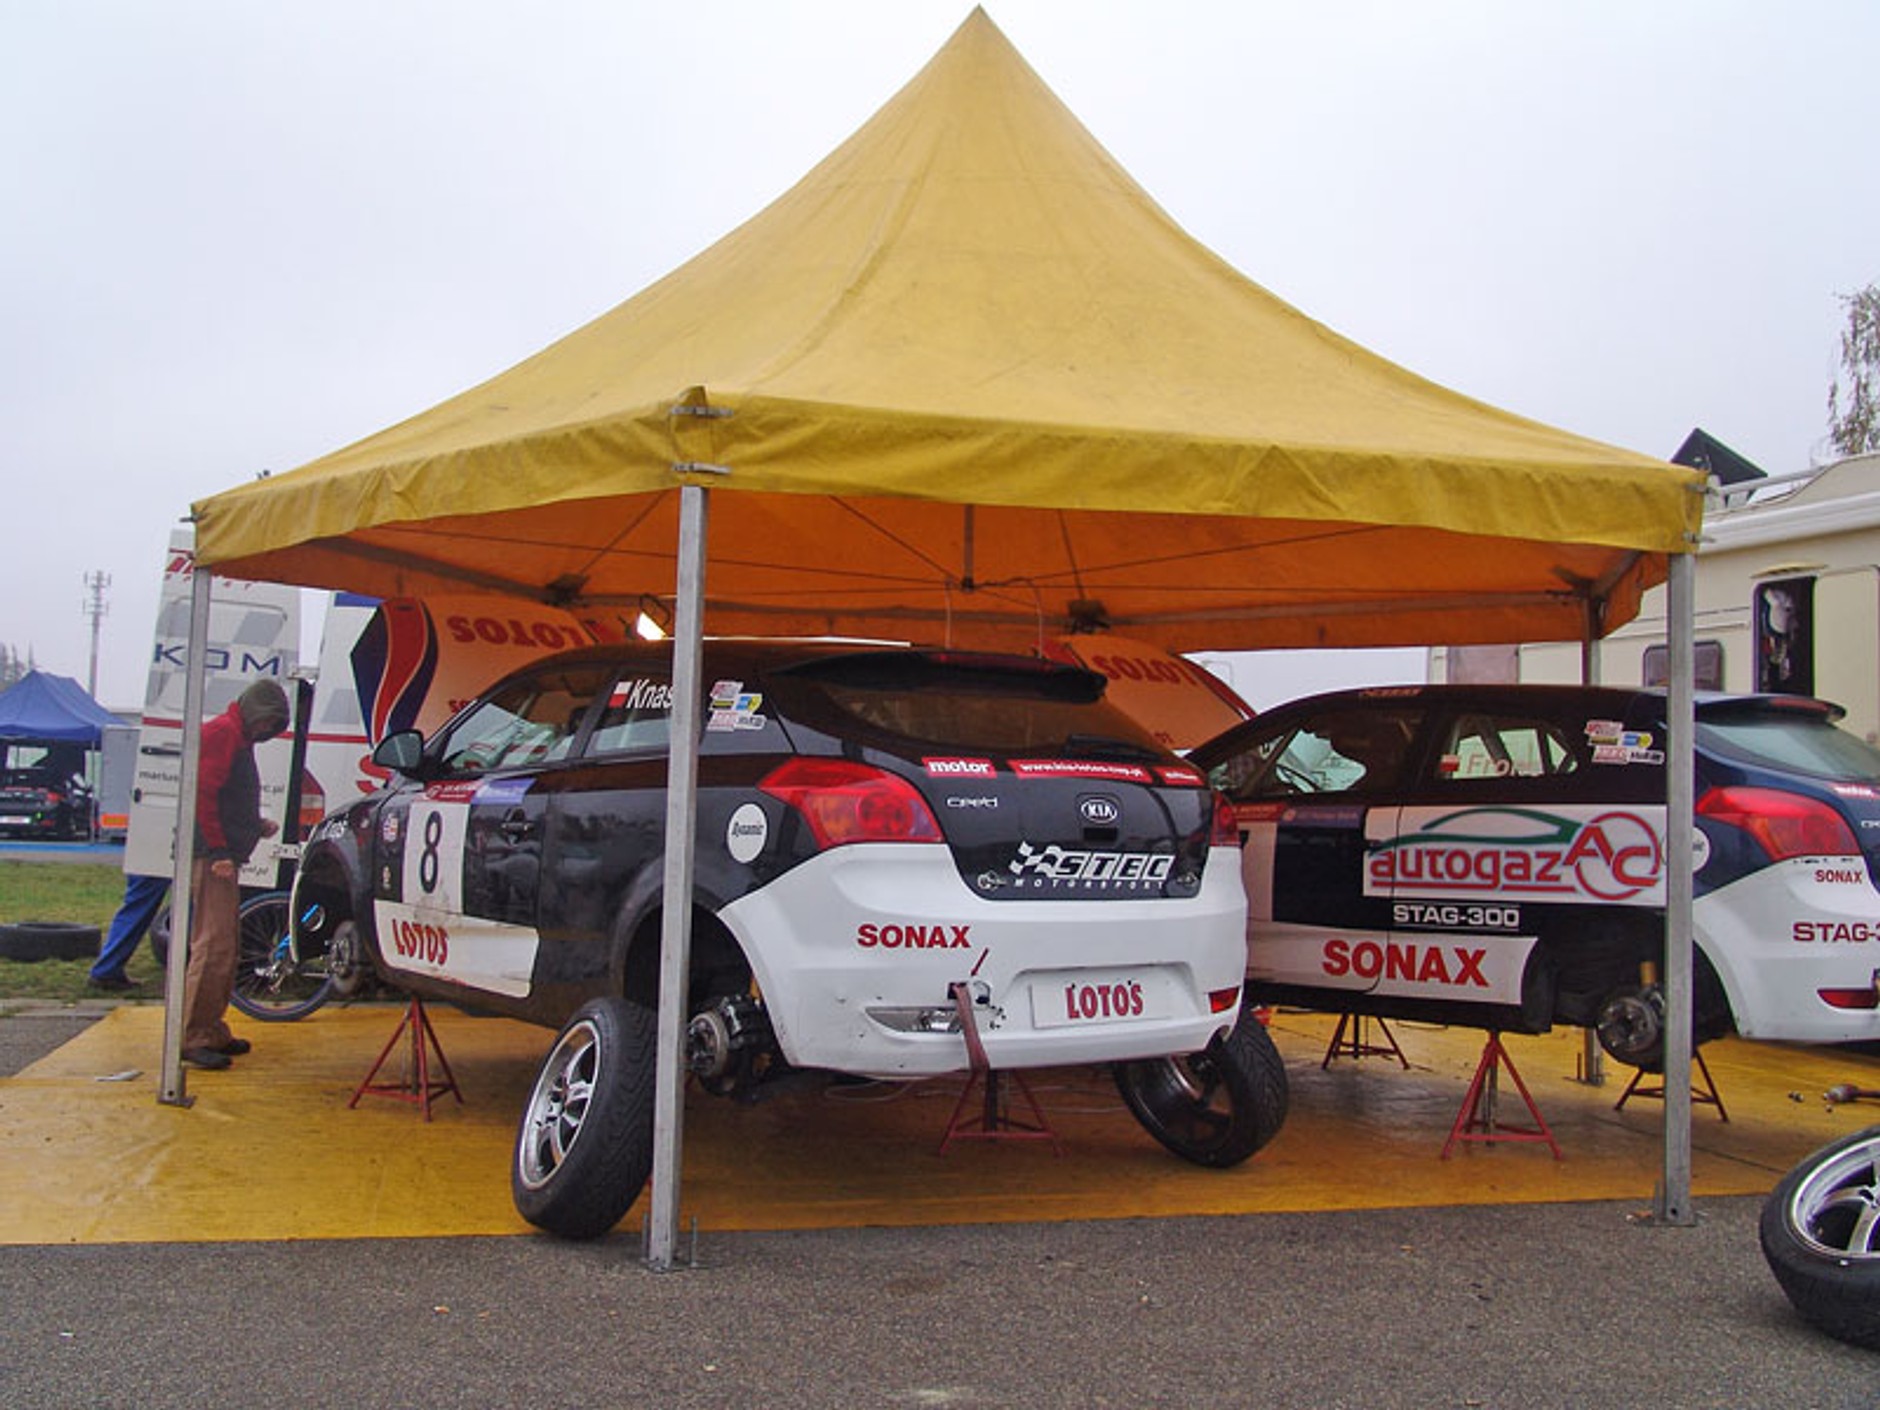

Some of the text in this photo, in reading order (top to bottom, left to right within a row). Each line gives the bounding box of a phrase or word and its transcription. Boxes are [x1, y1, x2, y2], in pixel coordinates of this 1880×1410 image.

[446, 616, 586, 650] LOTOS
[928, 761, 989, 774] motor
[420, 810, 443, 894] 8
[1369, 847, 1564, 889] autogaz
[1014, 878, 1166, 890] MOTORSPORT
[1815, 869, 1863, 884] SONAX
[1393, 903, 1520, 928] STAG-300
[392, 918, 449, 966] LOTOS
[857, 923, 972, 949] SONAX
[1323, 940, 1490, 988] SONAX
[1064, 983, 1144, 1019] LOTOS
